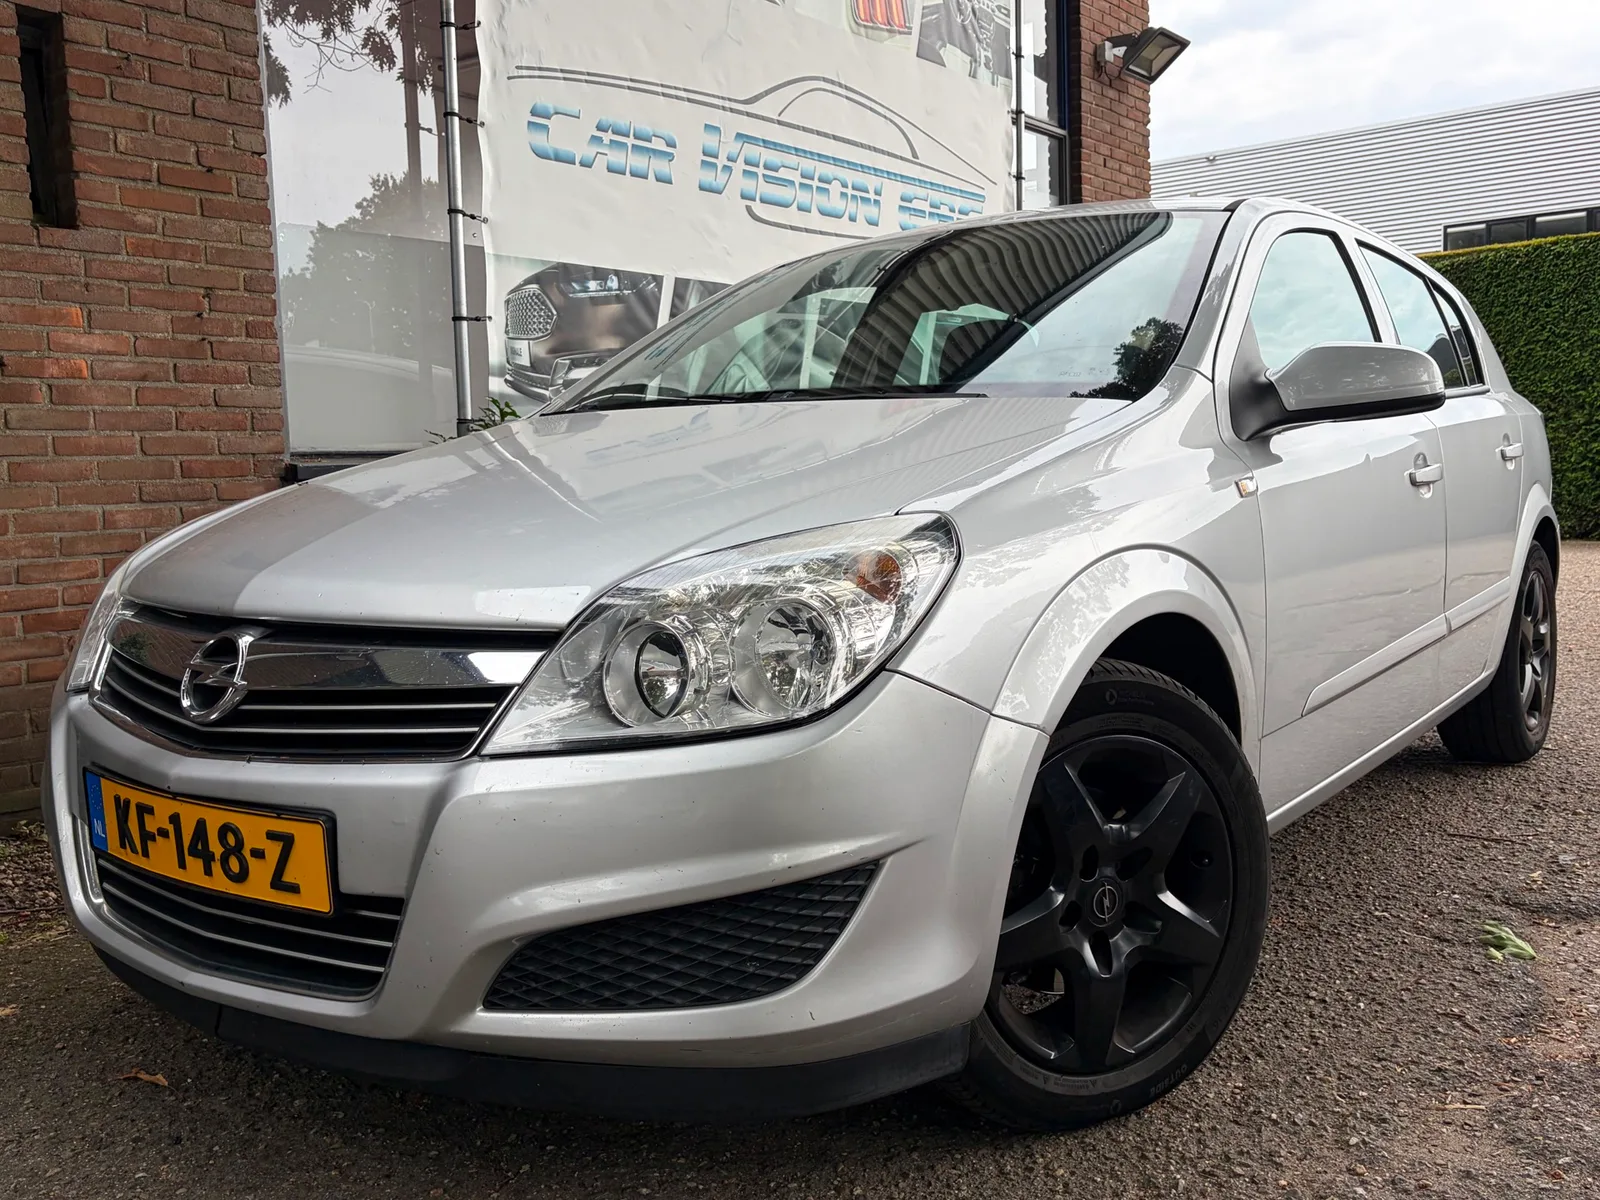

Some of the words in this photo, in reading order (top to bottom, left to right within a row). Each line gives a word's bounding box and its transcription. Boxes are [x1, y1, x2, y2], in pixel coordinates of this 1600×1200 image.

[527, 102, 677, 185] CAR
[699, 123, 883, 227] VISION
[94, 818, 106, 838] NL
[113, 794, 301, 894] KF-148-Z
